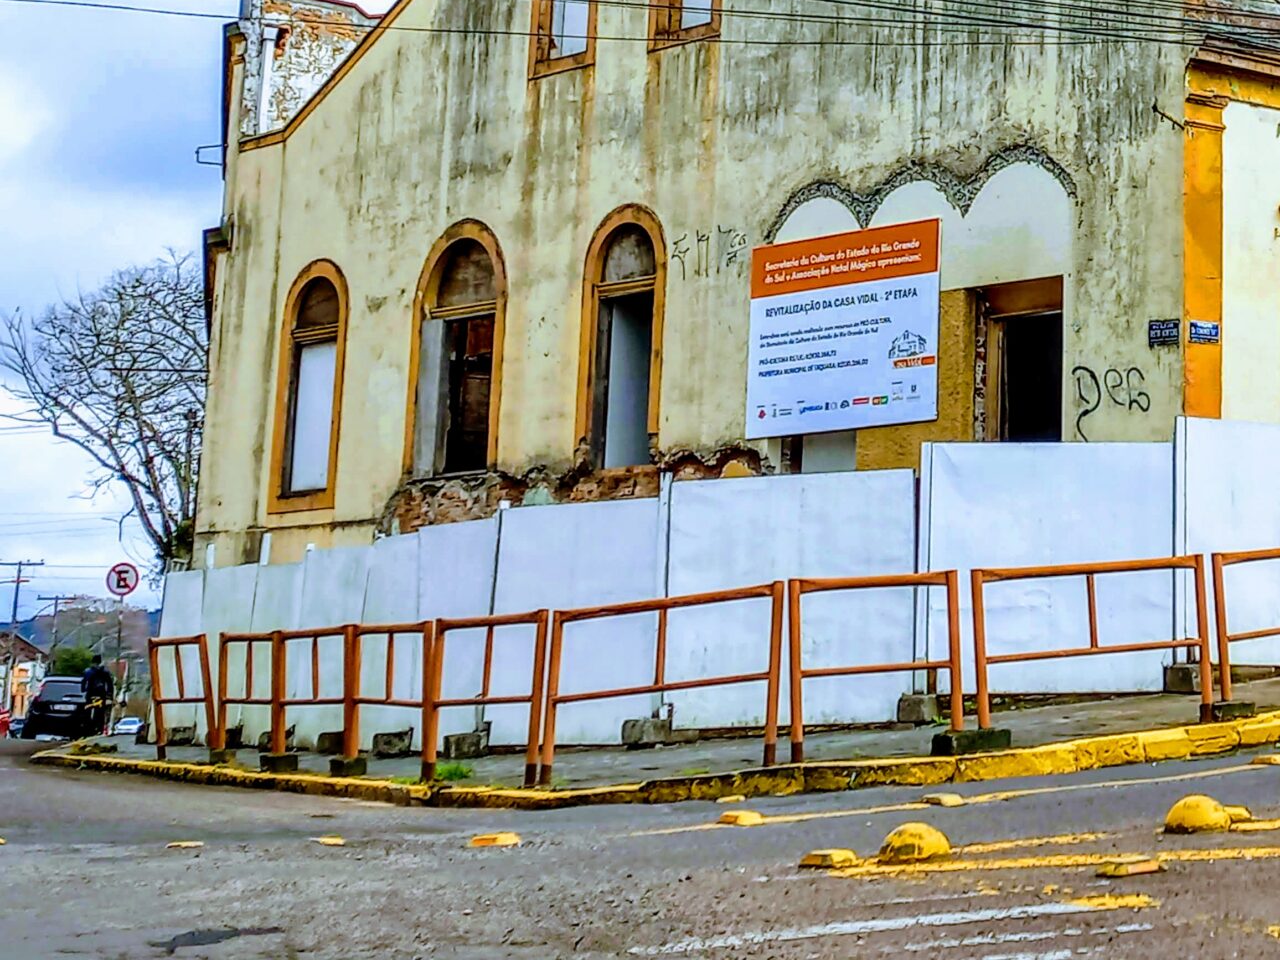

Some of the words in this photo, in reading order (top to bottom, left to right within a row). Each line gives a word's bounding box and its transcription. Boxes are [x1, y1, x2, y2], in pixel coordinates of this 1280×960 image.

[765, 257, 799, 272] Secretaria
[810, 252, 835, 264] Cultura
[836, 249, 845, 259] do
[846, 245, 869, 258] Estado
[881, 242, 892, 253] Rio
[893, 238, 920, 252] Grande
[774, 271, 785, 283] Sul
[831, 262, 849, 274] Natal
[765, 299, 821, 318] REVITALIZAÇÃO
[822, 299, 832, 310] DA
[834, 296, 855, 308] CASA
[856, 292, 878, 305] VIDAL
[893, 287, 918, 300] ETAPA
[116, 570, 129, 589] E
